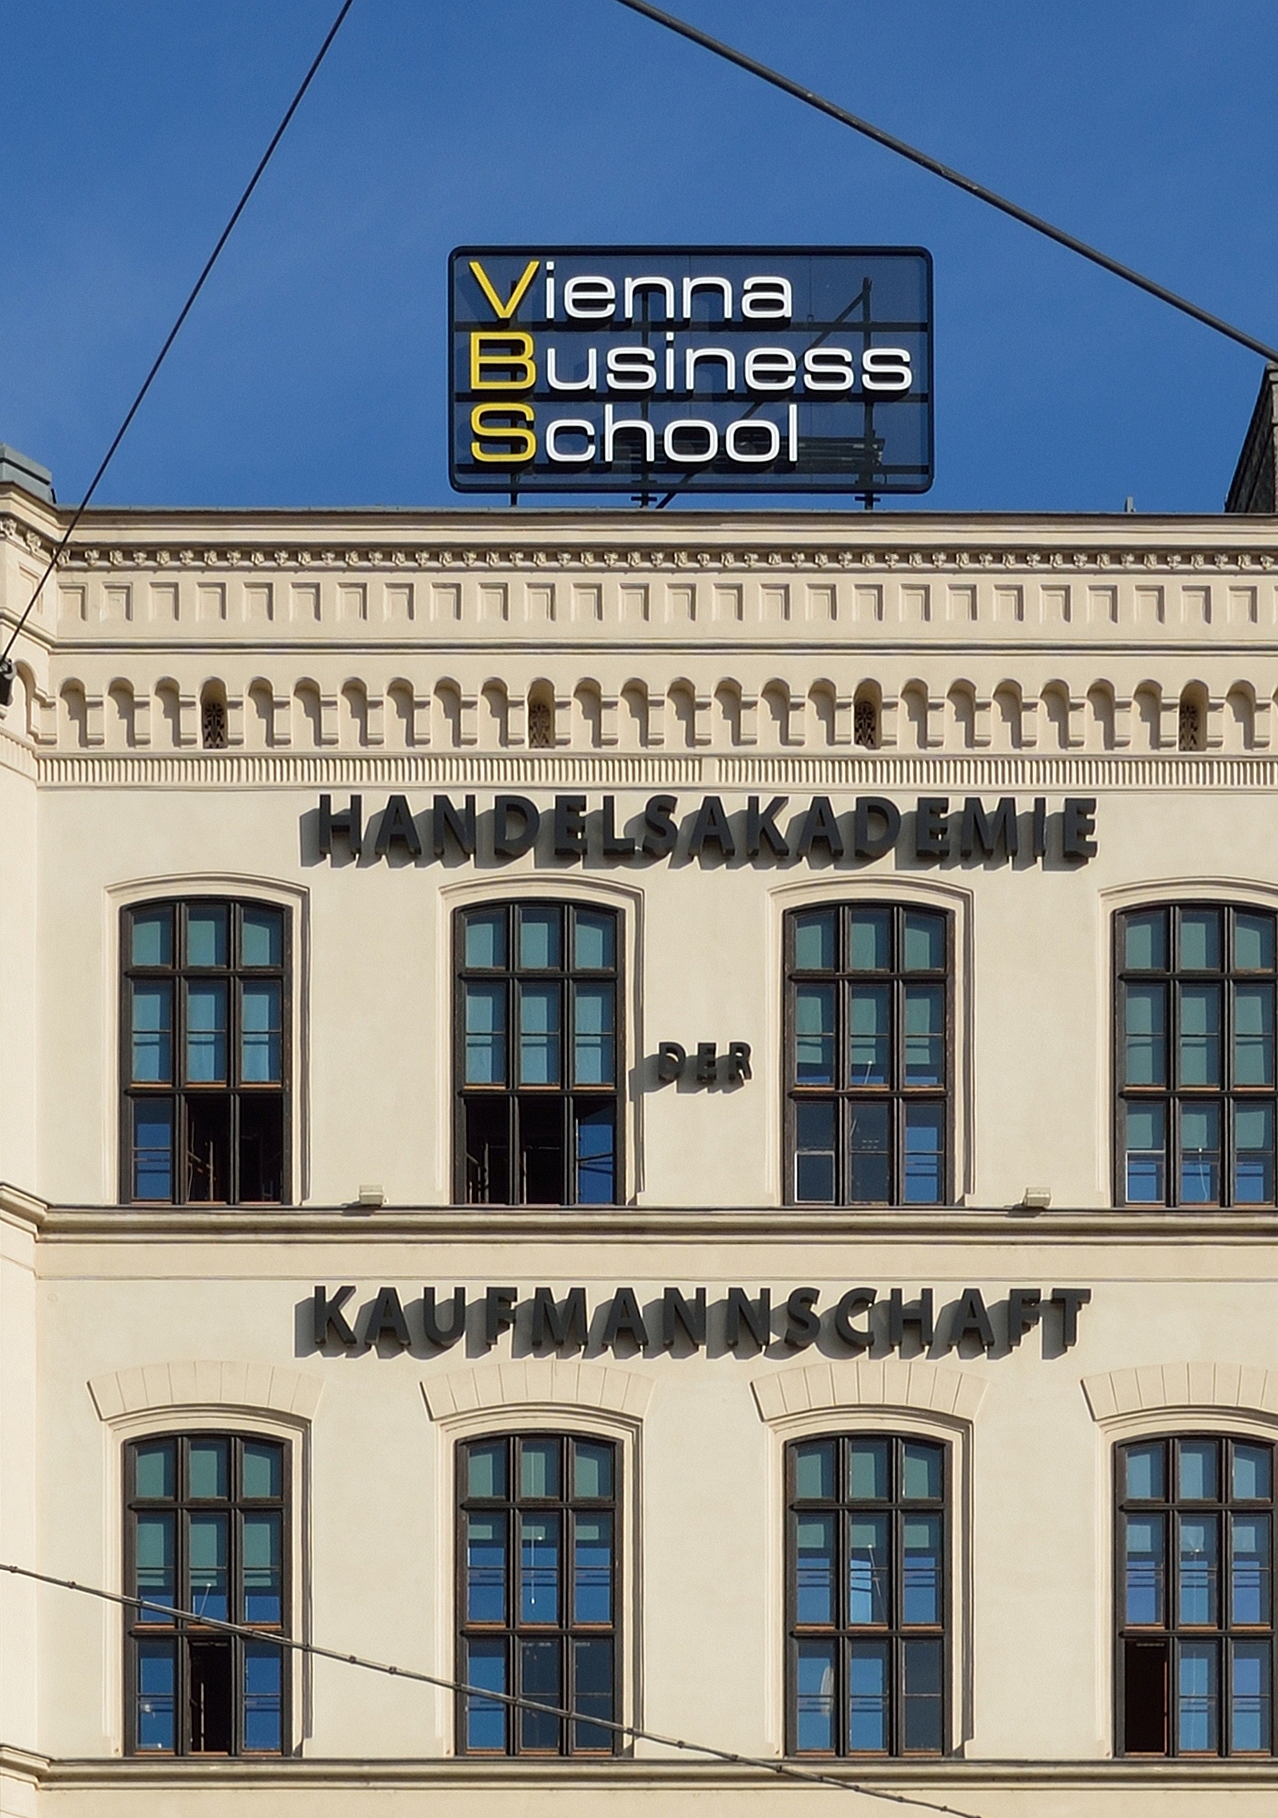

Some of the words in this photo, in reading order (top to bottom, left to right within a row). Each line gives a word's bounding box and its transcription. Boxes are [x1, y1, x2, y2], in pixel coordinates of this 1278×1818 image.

[468, 260, 793, 319] Vienna
[469, 331, 914, 391] Business
[469, 402, 799, 463] School
[318, 793, 1099, 861] HANDELSAKADEMIE
[658, 1041, 752, 1083] DER
[312, 1284, 1092, 1350] KAUFMANNSCHAFT
